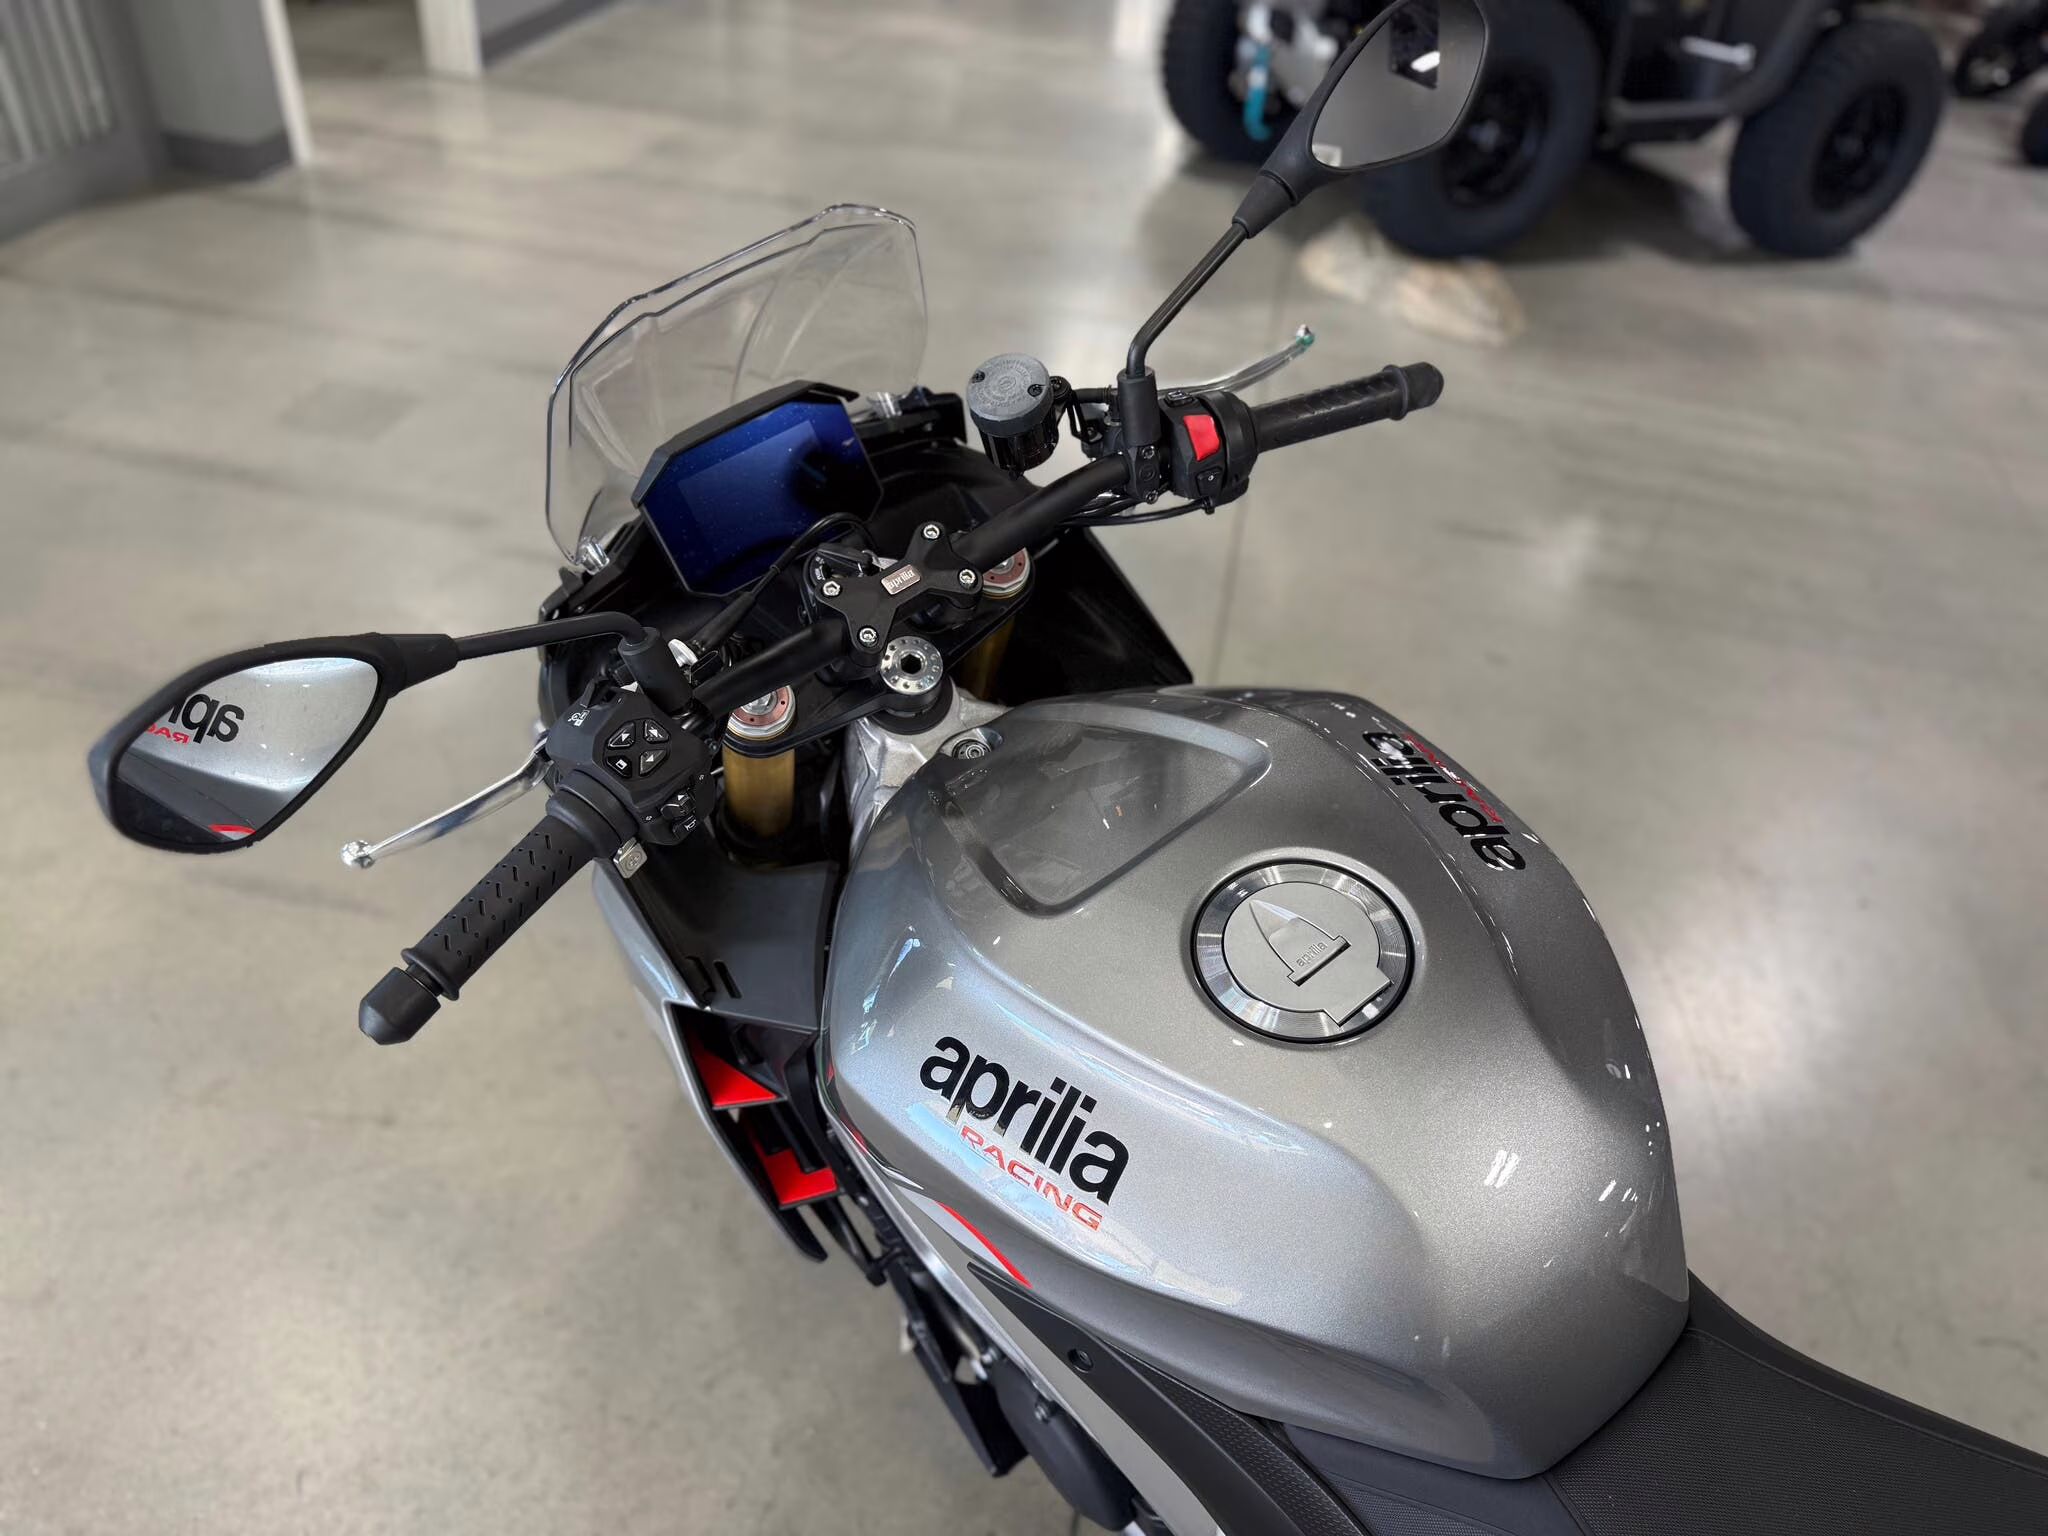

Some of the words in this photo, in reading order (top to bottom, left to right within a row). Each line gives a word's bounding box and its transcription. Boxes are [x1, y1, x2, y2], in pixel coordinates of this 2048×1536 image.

[1362, 732, 1526, 871] aprilia
[1296, 942, 1328, 967] aprilia
[920, 1036, 1129, 1206] aprilia
[961, 1125, 1103, 1231] RACING
